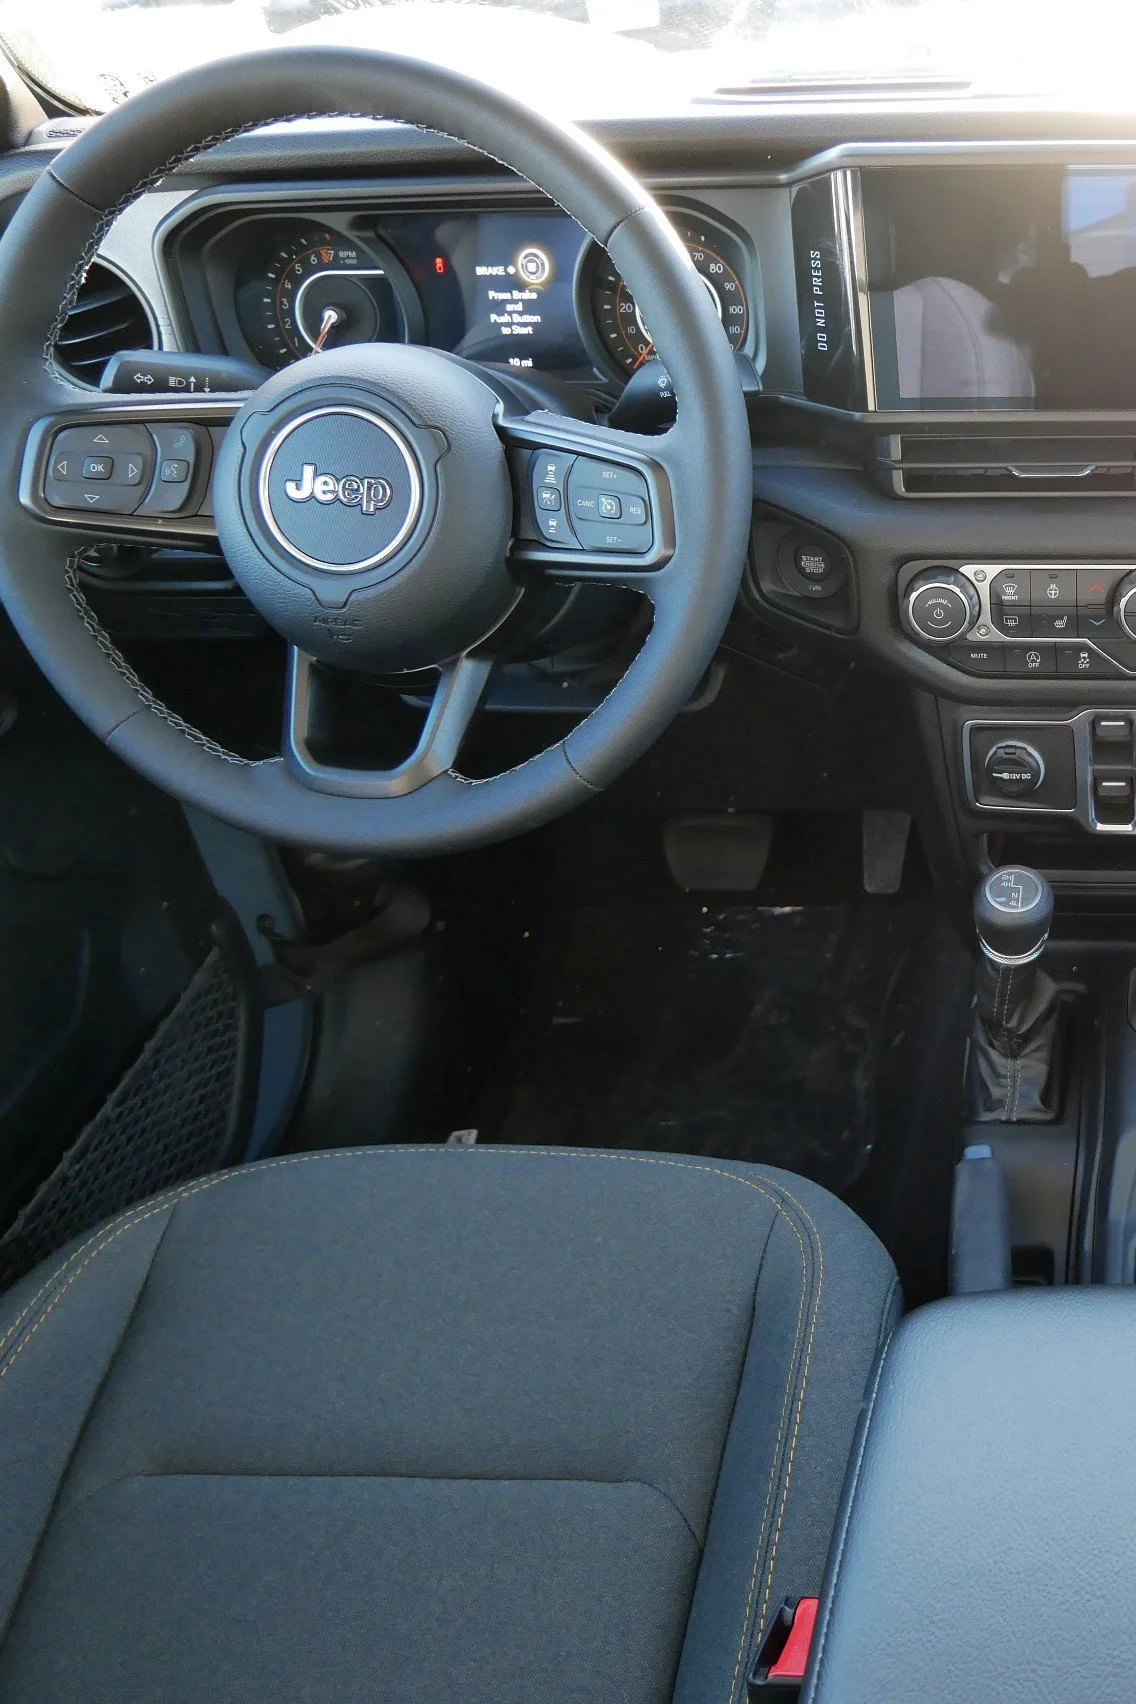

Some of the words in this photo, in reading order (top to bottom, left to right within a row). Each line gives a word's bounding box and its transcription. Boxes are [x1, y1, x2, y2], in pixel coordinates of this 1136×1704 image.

[310, 254, 317, 264] 6
[693, 253, 704, 261] 70
[295, 264, 302, 274] 5
[475, 266, 505, 276] BRAKE
[709, 263, 724, 274] 80
[810, 251, 823, 294] PRESS
[285, 280, 292, 290] 4
[724, 282, 736, 291] 90
[488, 290, 511, 300] Press
[512, 290, 537, 300] Brake
[281, 299, 289, 309] 3
[505, 302, 523, 312] and
[619, 303, 633, 313] 20
[729, 305, 743, 314] 100
[814, 301, 826, 327] NOT
[490, 314, 512, 323] Push
[513, 314, 541, 323] Button
[284, 319, 291, 329] 2
[501, 326, 511, 335] to
[512, 325, 533, 335] Start
[627, 326, 636, 334] 10
[729, 326, 740, 334] 110
[817, 333, 828, 351] DO
[638, 344, 646, 353] 0
[521, 358, 533, 367] mi
[659, 390, 672, 398] PULL
[90, 463, 105, 472] OK
[285, 462, 393, 515] Jeep
[577, 500, 595, 508] CANC
[927, 598, 948, 606] VOLUME
